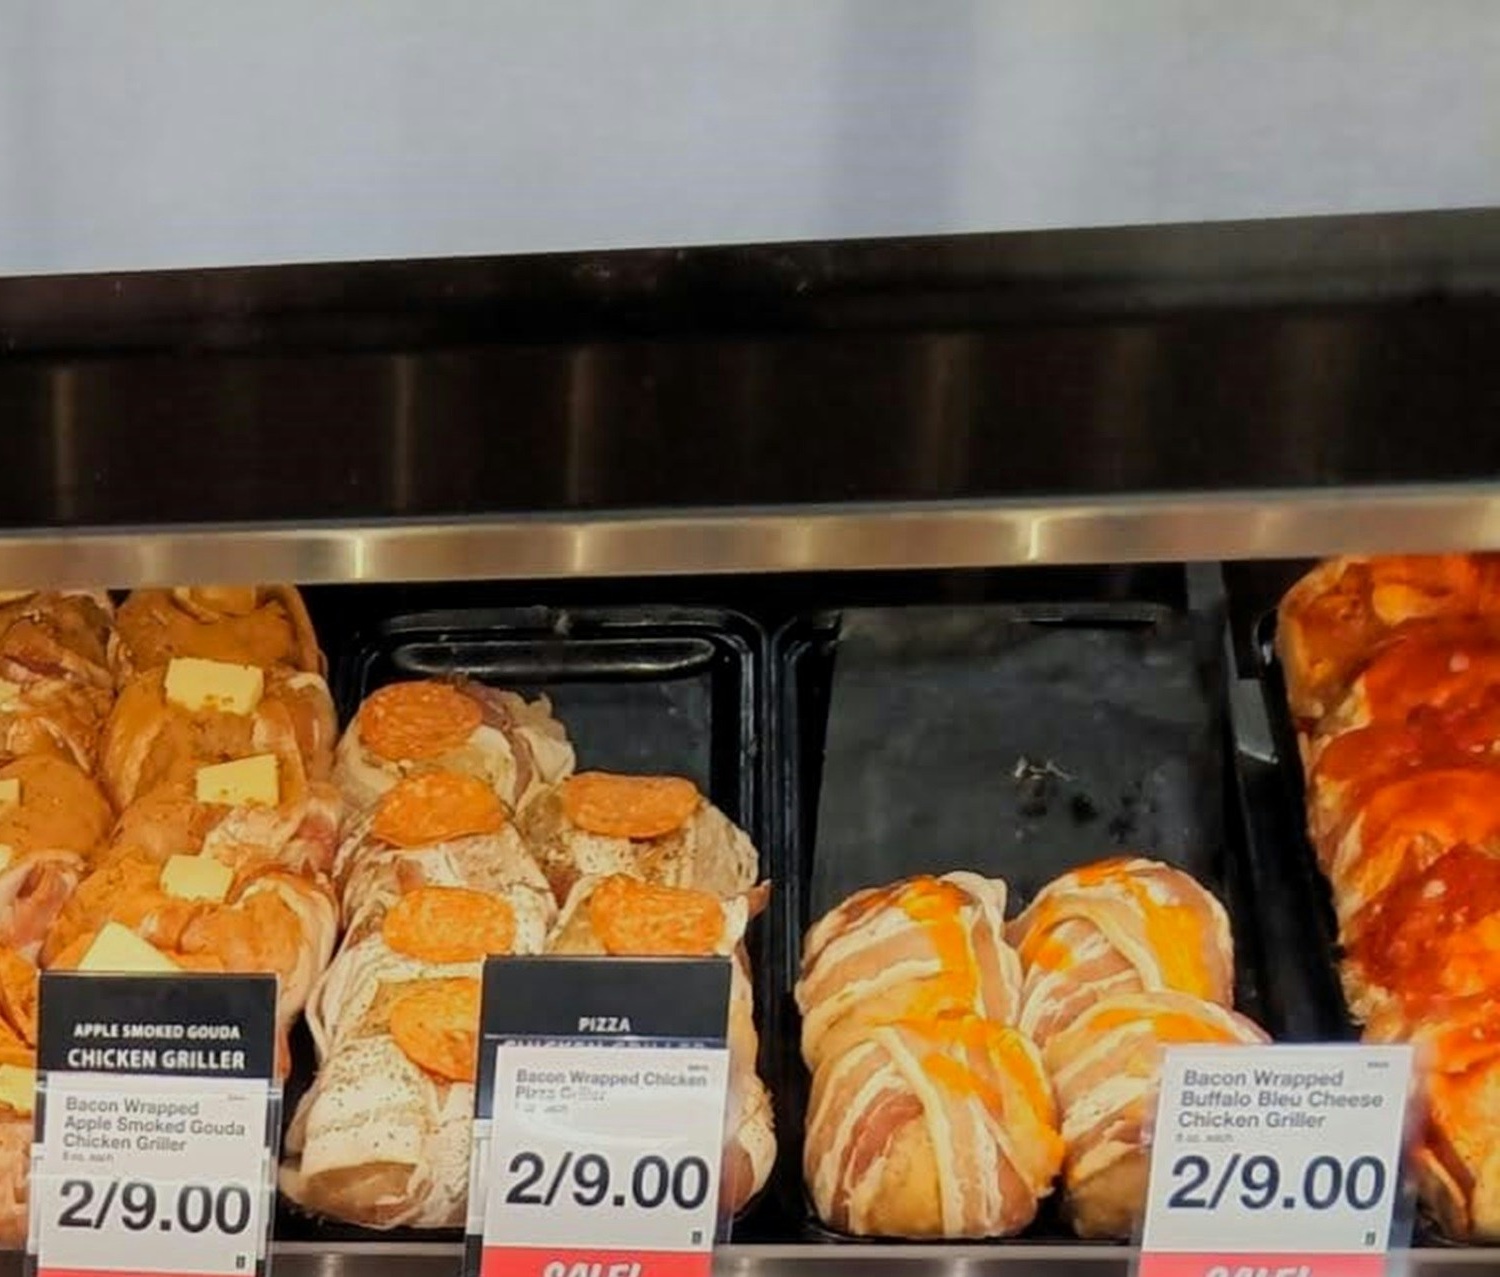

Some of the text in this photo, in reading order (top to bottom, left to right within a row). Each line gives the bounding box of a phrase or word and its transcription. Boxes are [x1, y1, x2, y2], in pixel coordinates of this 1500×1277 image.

[74, 1024, 240, 1039] APPLE SMOKED GOUDA
[579, 1017, 631, 1032] PIZZA
[67, 1049, 245, 1070] CHICKEN GRILLER
[516, 1069, 706, 1087] Bacon Wrapped Chicken
[1183, 1069, 1343, 1090] Bacon Wrapped
[66, 1097, 199, 1116] Bacon Wrapped
[1180, 1090, 1384, 1108] Buffalo Bleu Cheese
[64, 1117, 245, 1136] Apple Smoked Gouda
[1178, 1111, 1326, 1128] Chicken Griller
[63, 1134, 187, 1151] Chicken Griller
[505, 1151, 709, 1210] 2/9.00
[1167, 1153, 1386, 1210] 2/9.00
[58, 1180, 250, 1235] 2/9.00
